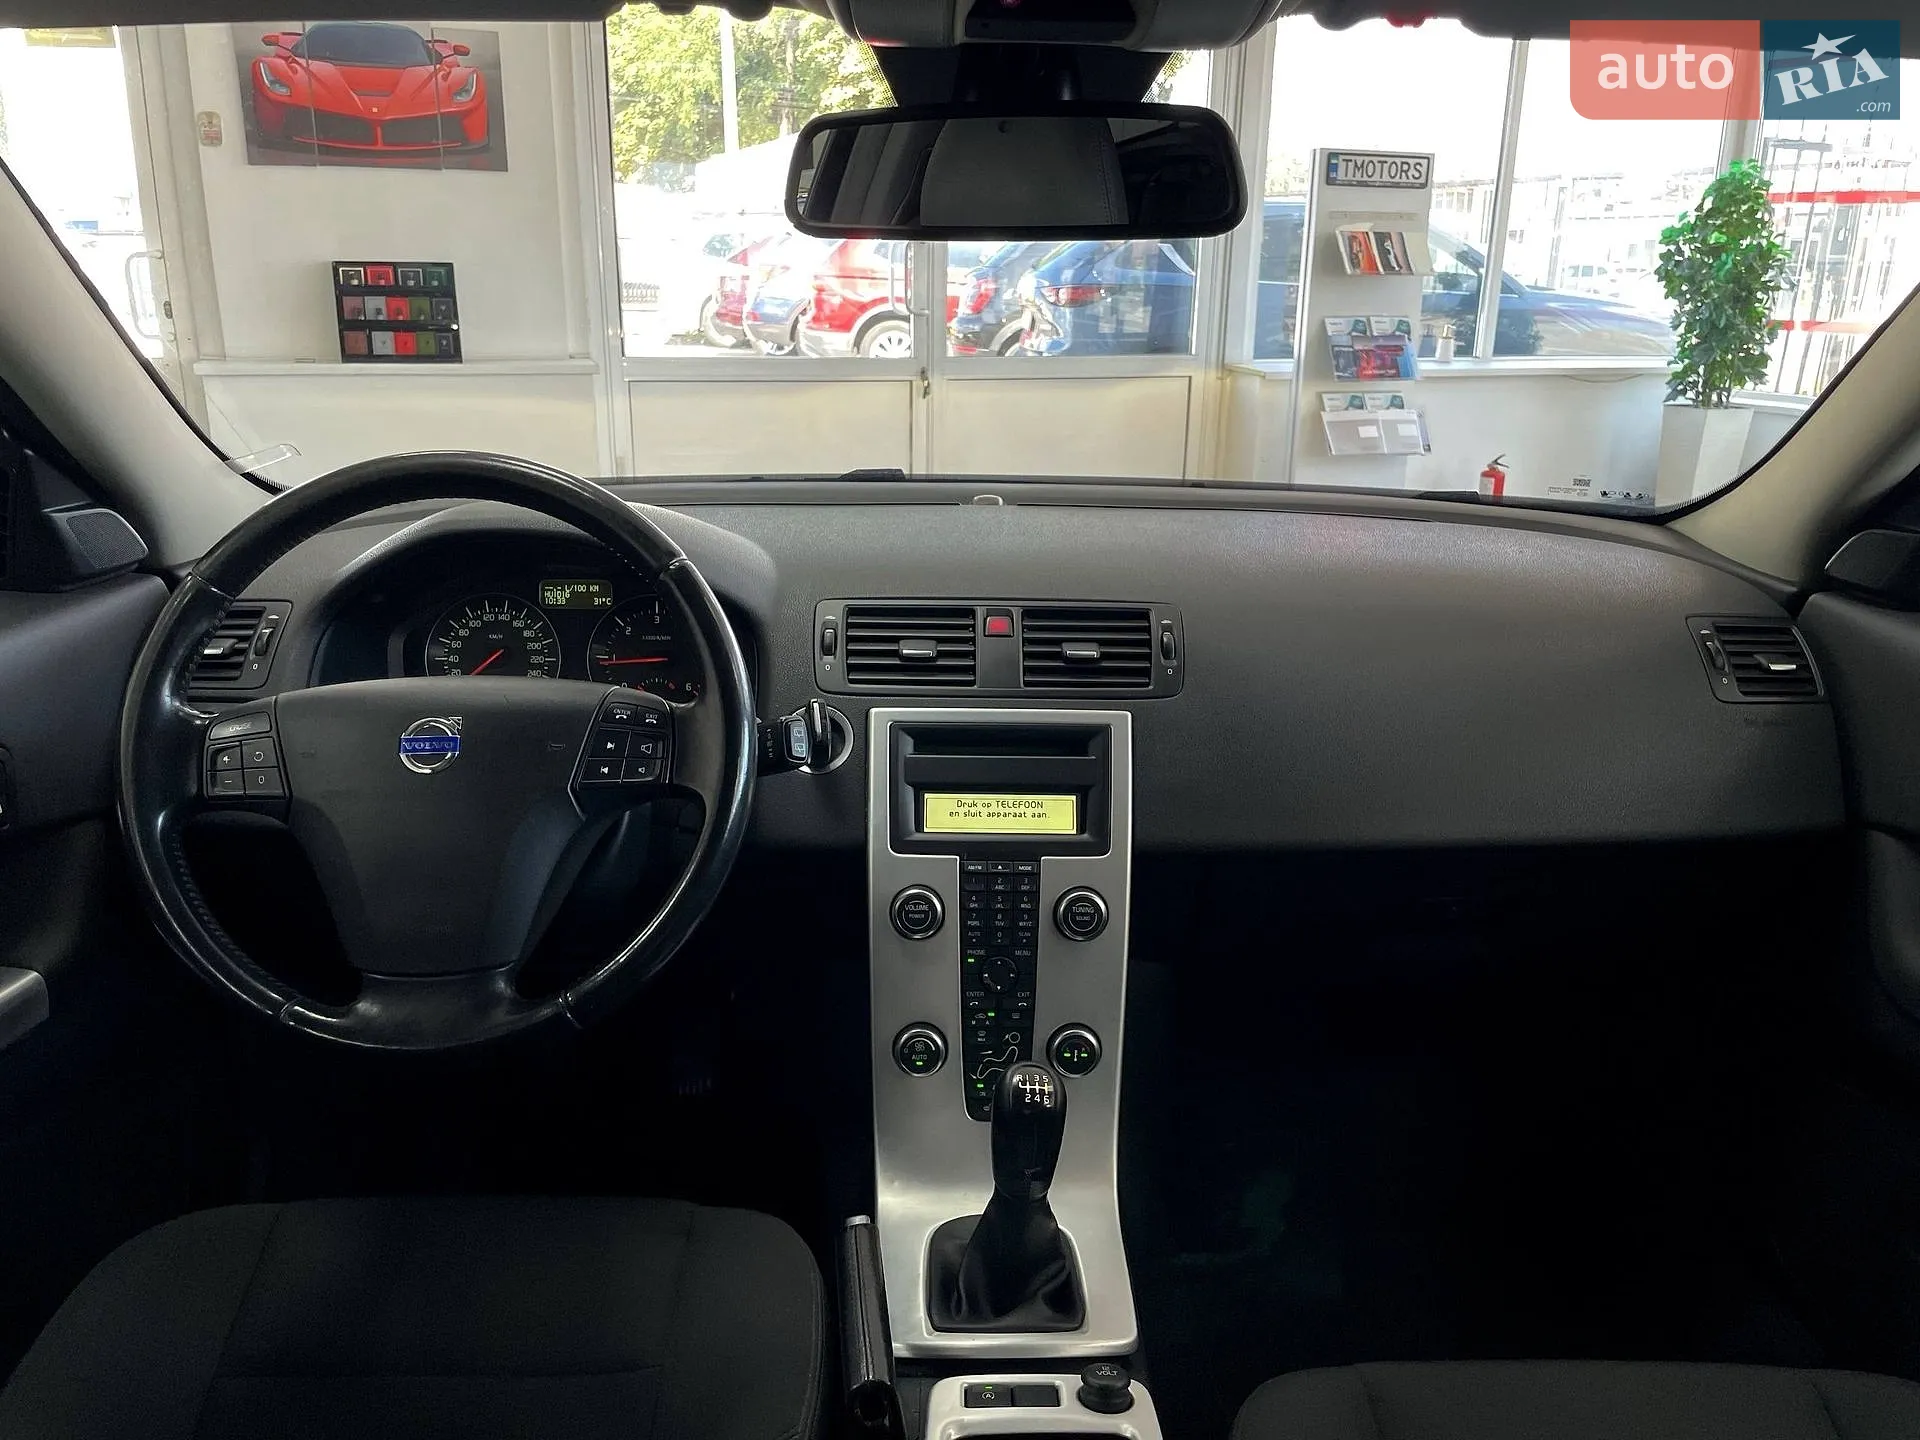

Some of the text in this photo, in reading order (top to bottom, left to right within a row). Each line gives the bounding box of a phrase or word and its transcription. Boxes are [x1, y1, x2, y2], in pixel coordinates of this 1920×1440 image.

[1342, 159, 1423, 180] TMOTORS
[546, 597, 566, 605] 10:33
[483, 613, 495, 621] 120
[498, 613, 510, 621] 140
[654, 616, 660, 624] 3
[512, 620, 525, 628] 160
[458, 628, 469, 636] 80
[626, 626, 632, 635] 2
[451, 640, 462, 648] 60
[685, 683, 692, 692] 6
[956, 800, 1044, 810] Druk op TELEFOON
[963, 810, 982, 818] sluit
[986, 811, 1027, 820] apparaat
[1025, 1094, 1032, 1103] 2
[1033, 1094, 1041, 1103] 4
[1043, 1096, 1050, 1105] 6
